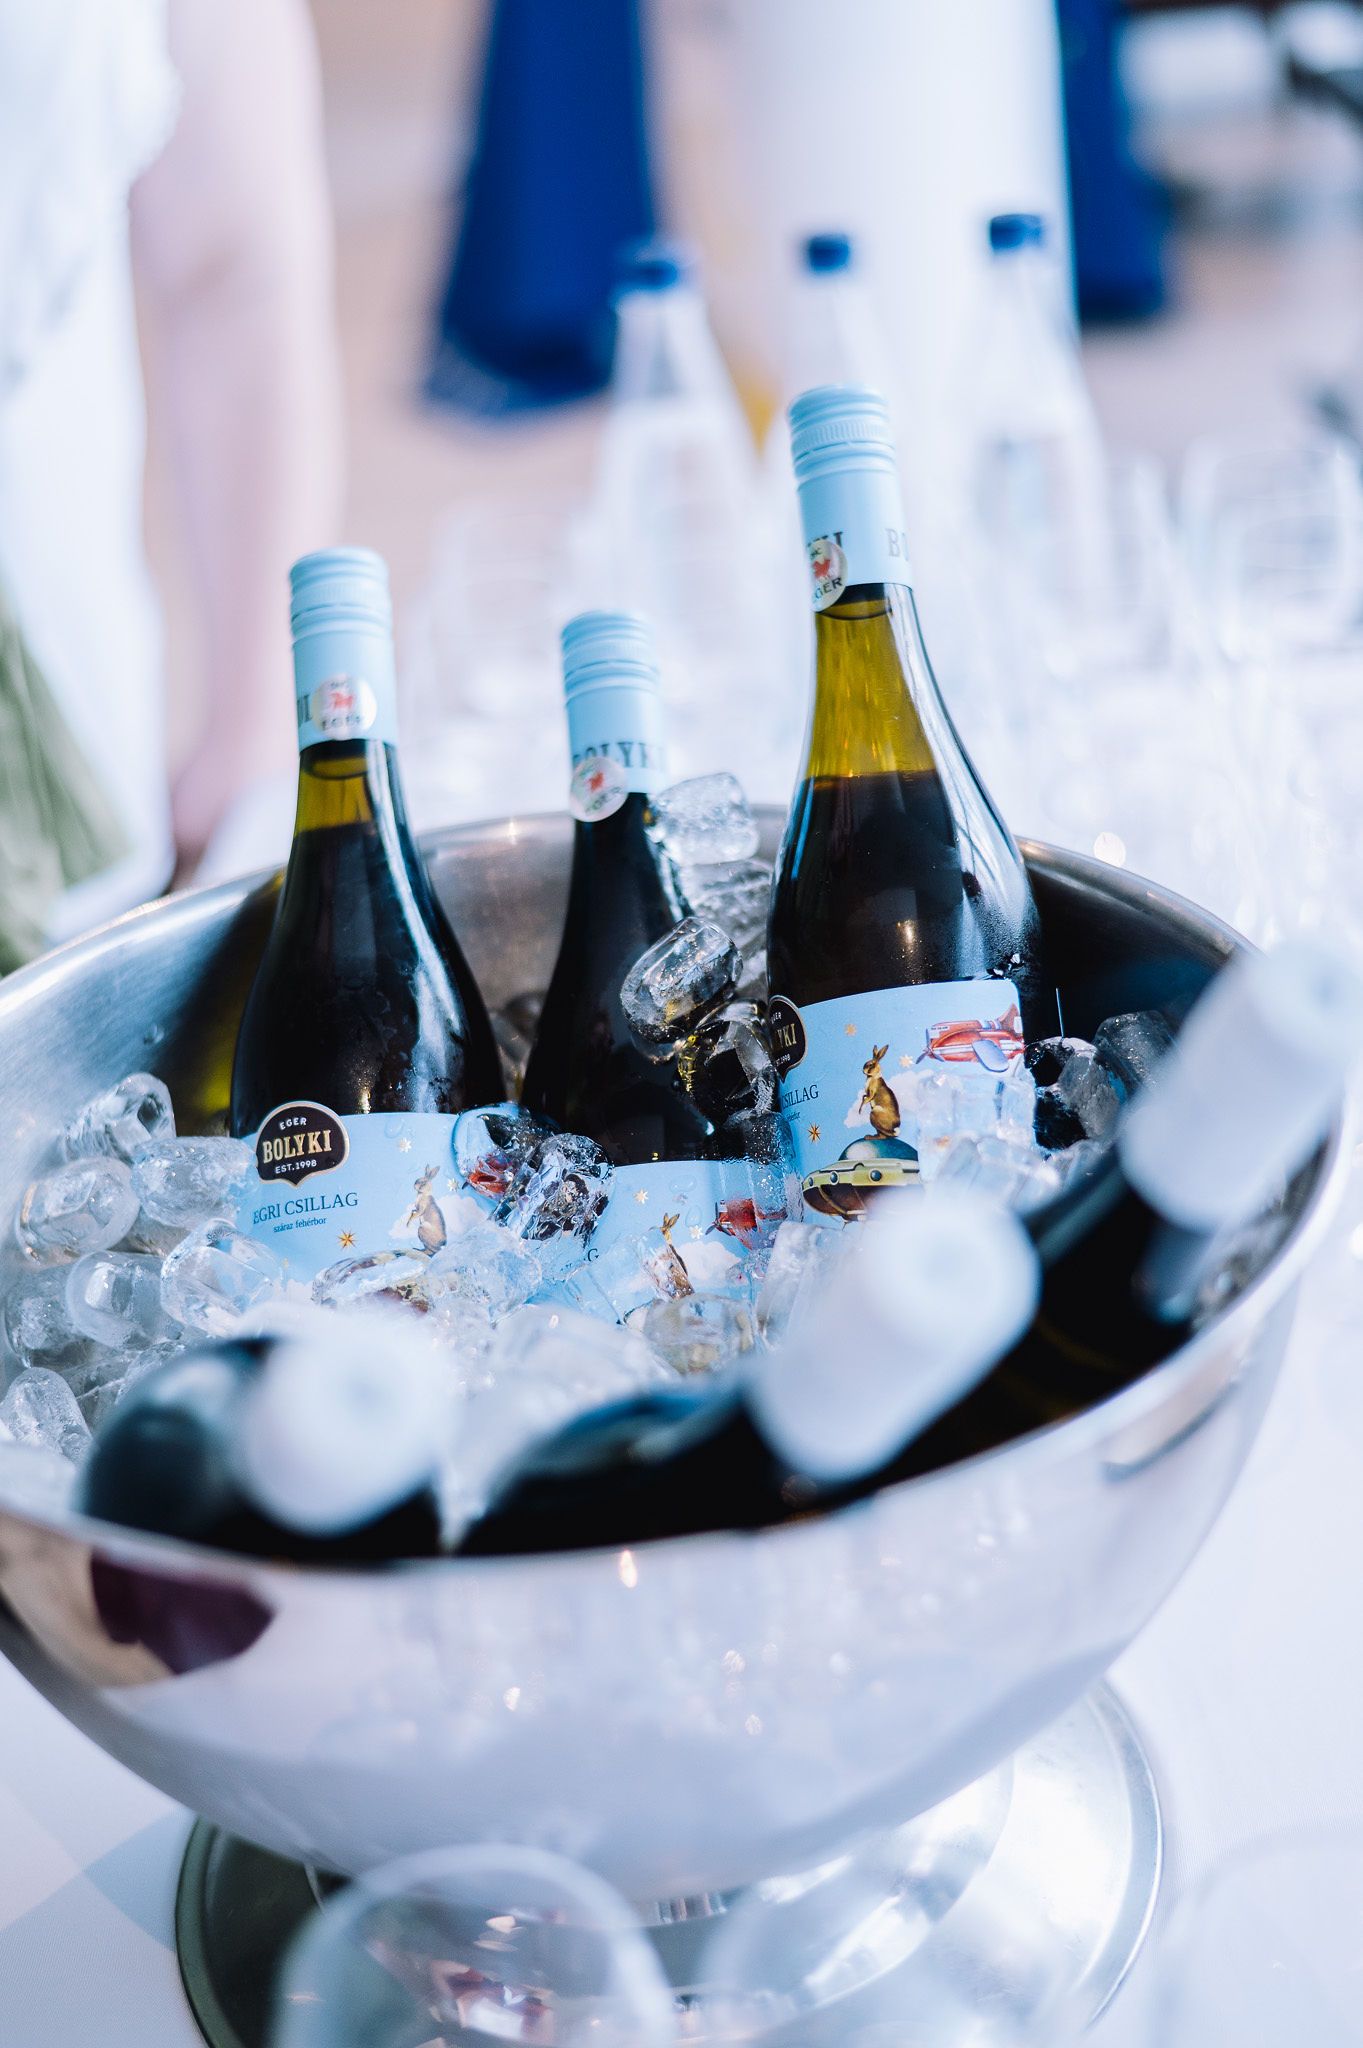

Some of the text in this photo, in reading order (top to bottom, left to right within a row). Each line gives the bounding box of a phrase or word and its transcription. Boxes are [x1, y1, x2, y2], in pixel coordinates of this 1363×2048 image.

[811, 577, 843, 602] GER
[279, 1117, 307, 1131] EGER
[262, 1129, 332, 1164] BOLYKI
[253, 1192, 358, 1225] EGRI CSILLAG
